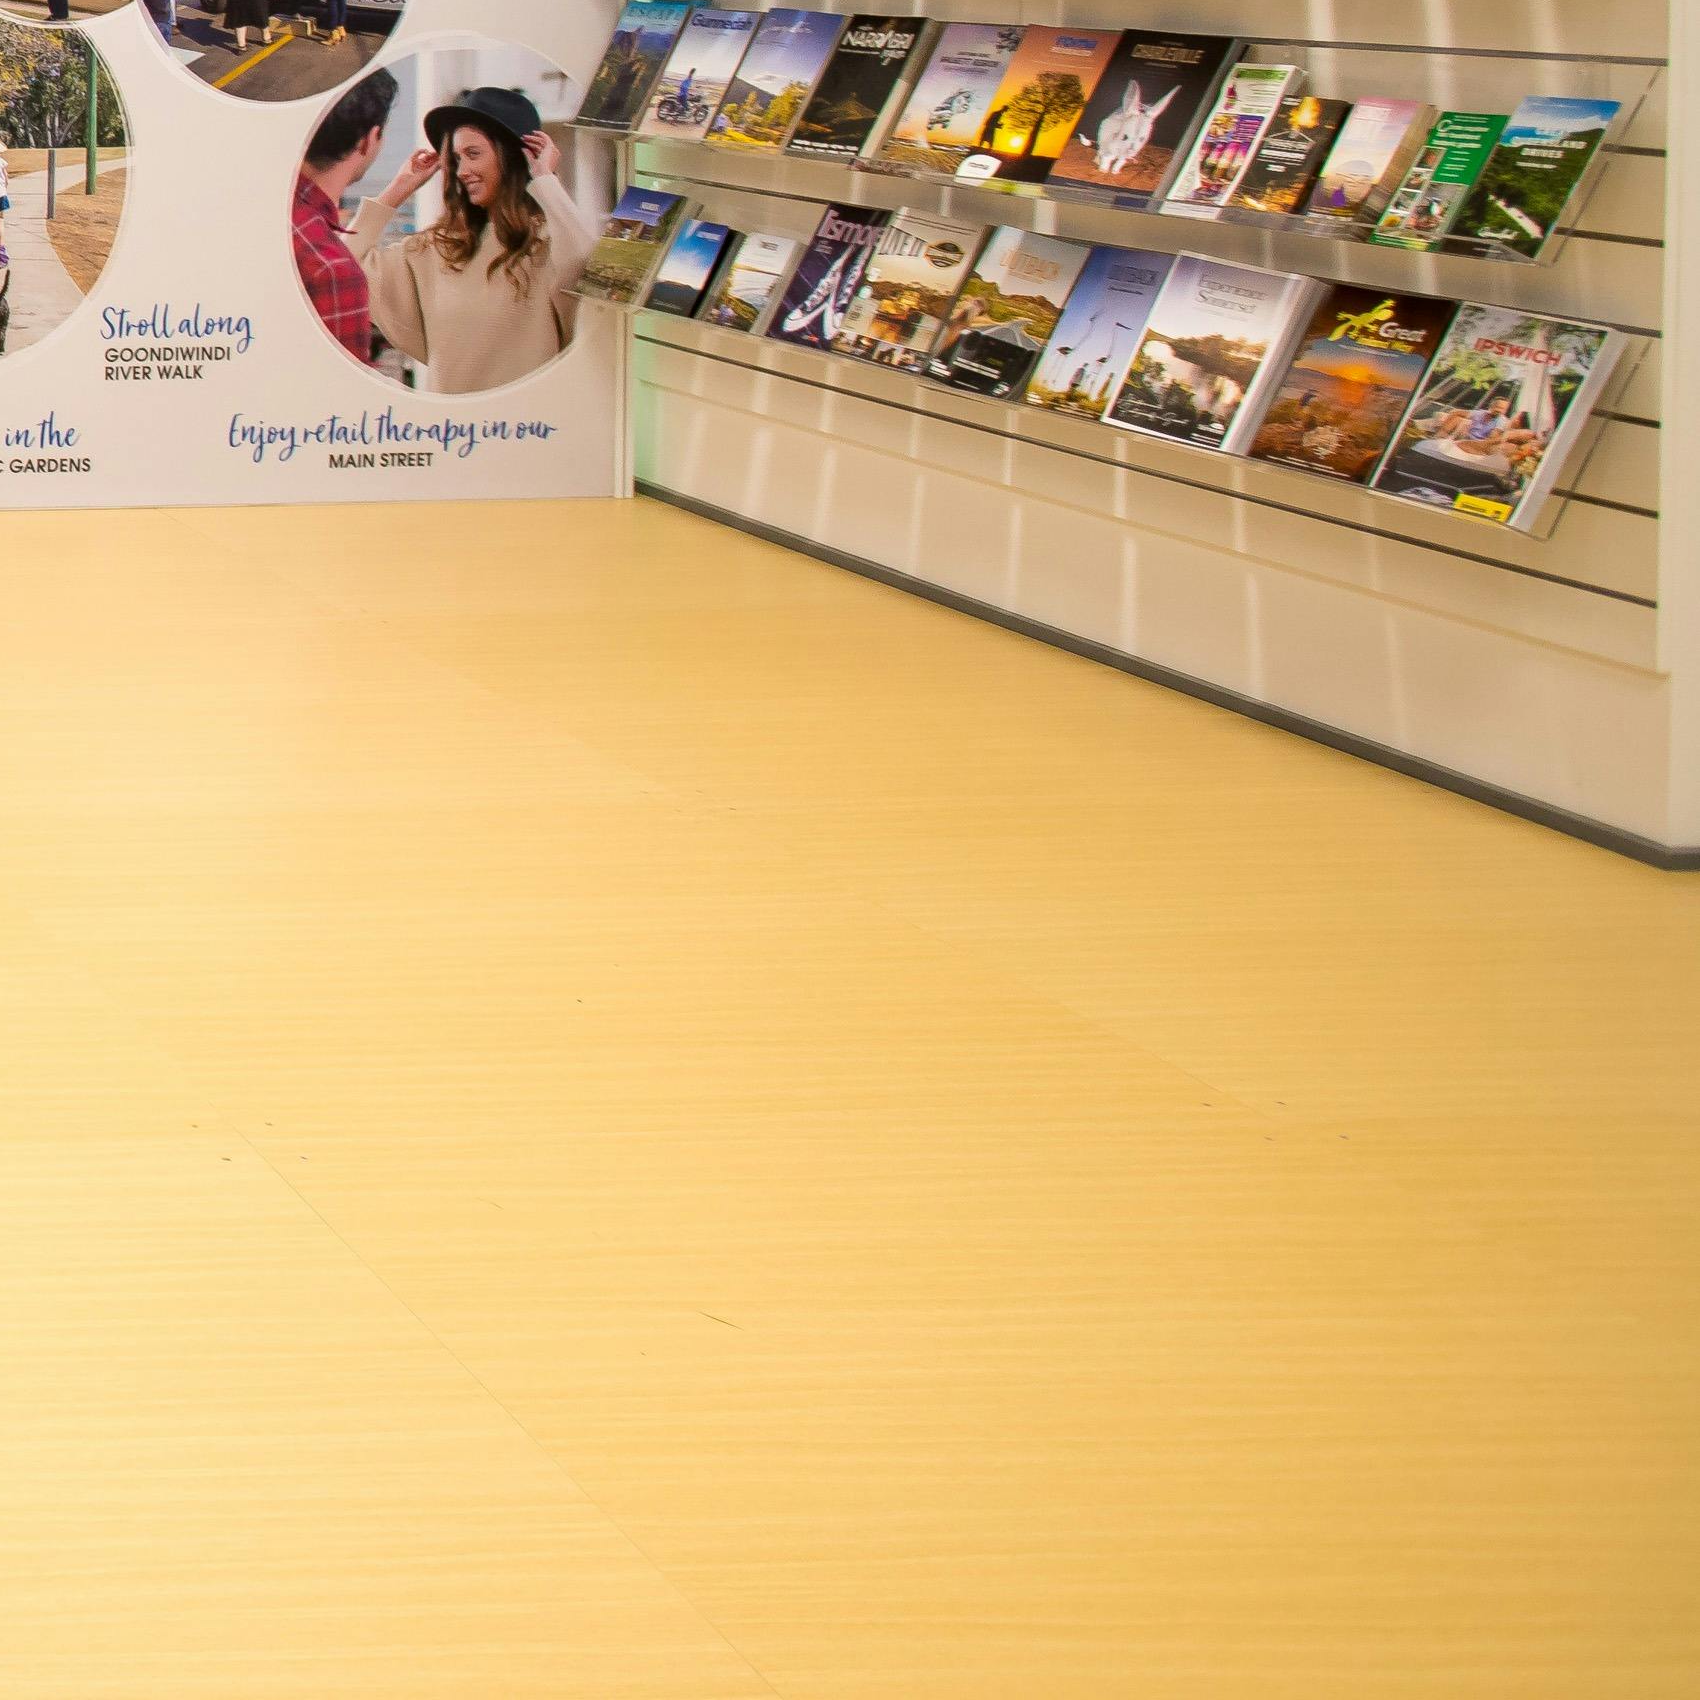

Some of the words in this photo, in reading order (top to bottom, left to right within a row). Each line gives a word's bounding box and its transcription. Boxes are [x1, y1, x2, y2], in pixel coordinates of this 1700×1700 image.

[100, 304, 175, 341] Stroll
[175, 304, 256, 354] along
[105, 347, 231, 363] GOONDIWINDI
[1474, 337, 1561, 365] IPSWICH
[105, 366, 151, 380] RIVER
[157, 365, 202, 379] WALK
[6, 429, 34, 447] in
[38, 411, 74, 448] the
[229, 412, 301, 463] Enjoy
[302, 409, 371, 444] retail
[375, 406, 481, 456] therapy
[482, 418, 515, 443] in
[516, 422, 558, 442] our
[9, 458, 90, 472] GARDENS
[329, 453, 376, 468] MAIN
[380, 452, 434, 467] STREET
